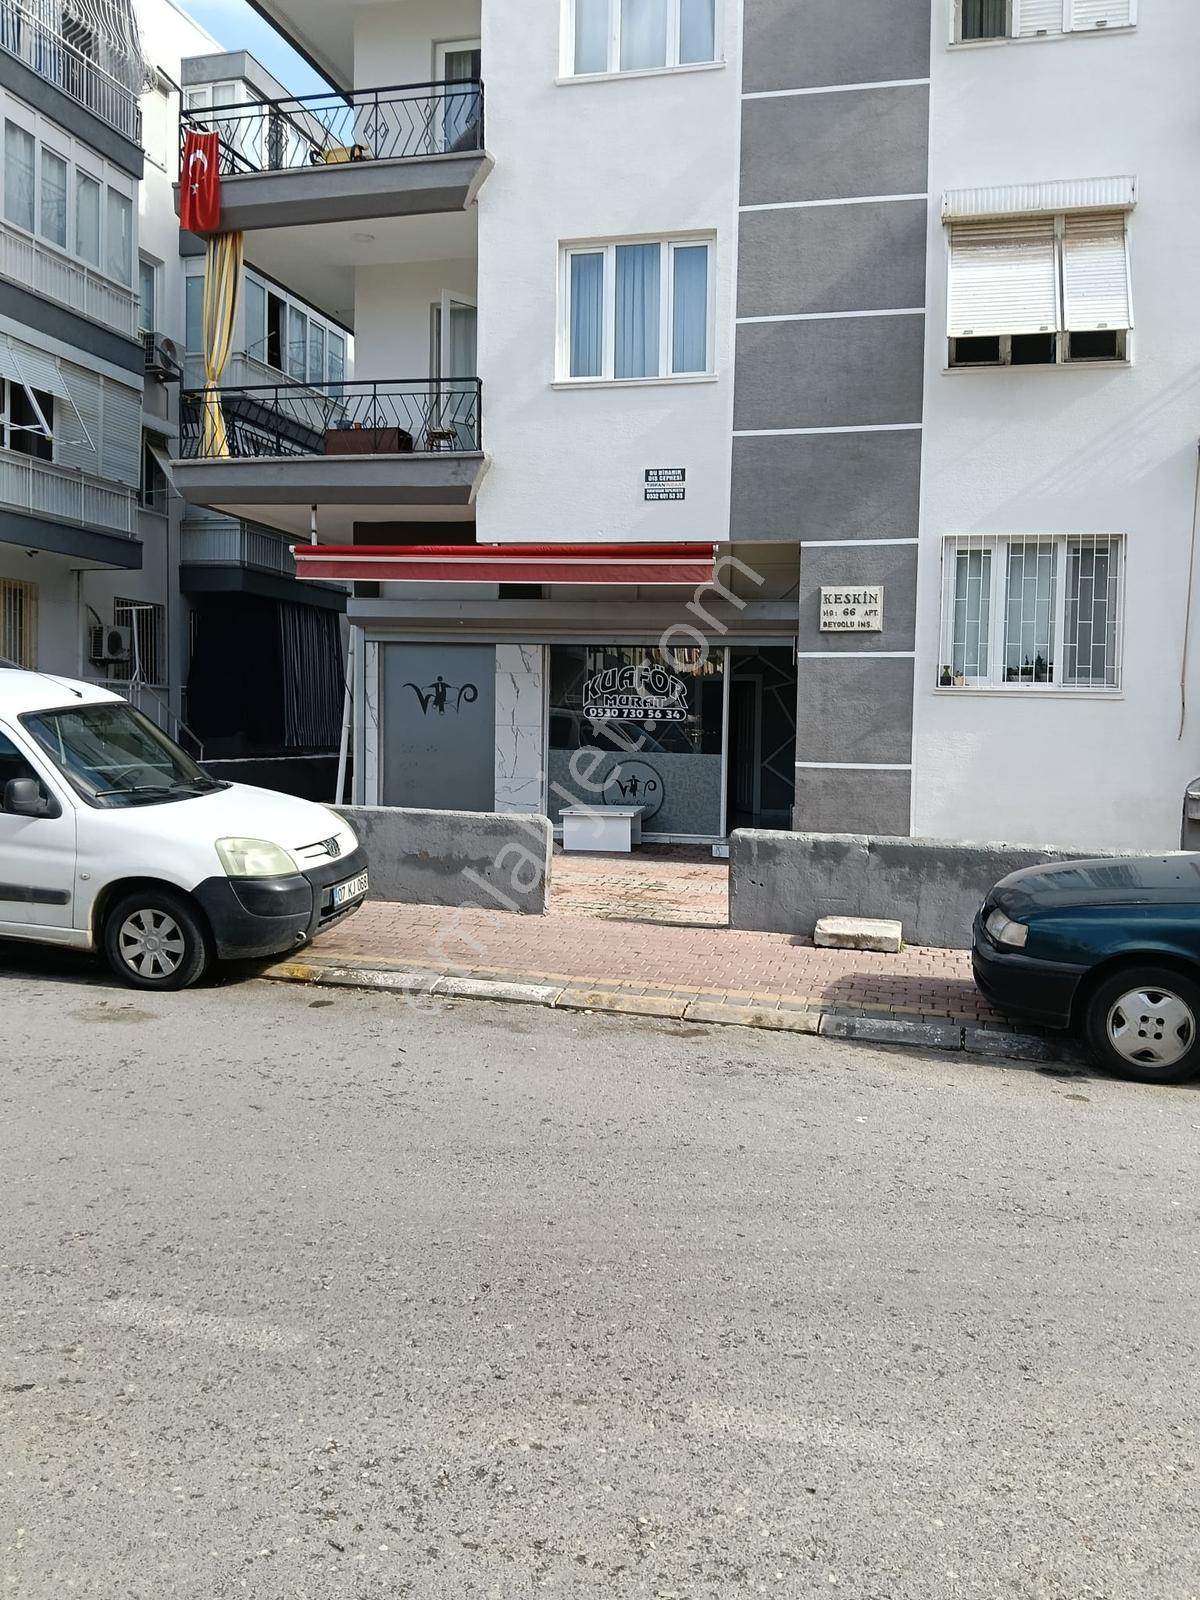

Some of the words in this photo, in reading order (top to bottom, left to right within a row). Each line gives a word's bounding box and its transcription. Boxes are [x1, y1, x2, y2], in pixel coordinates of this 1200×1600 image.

[823, 591, 878, 604] KESKİN
[842, 607, 856, 616] 66
[582, 664, 689, 709] KUAFÖR
[603, 694, 667, 708] MURAT
[589, 708, 619, 718] 0530
[622, 709, 644, 718] 730
[647, 710, 662, 719] 56
[665, 710, 680, 719] 34
